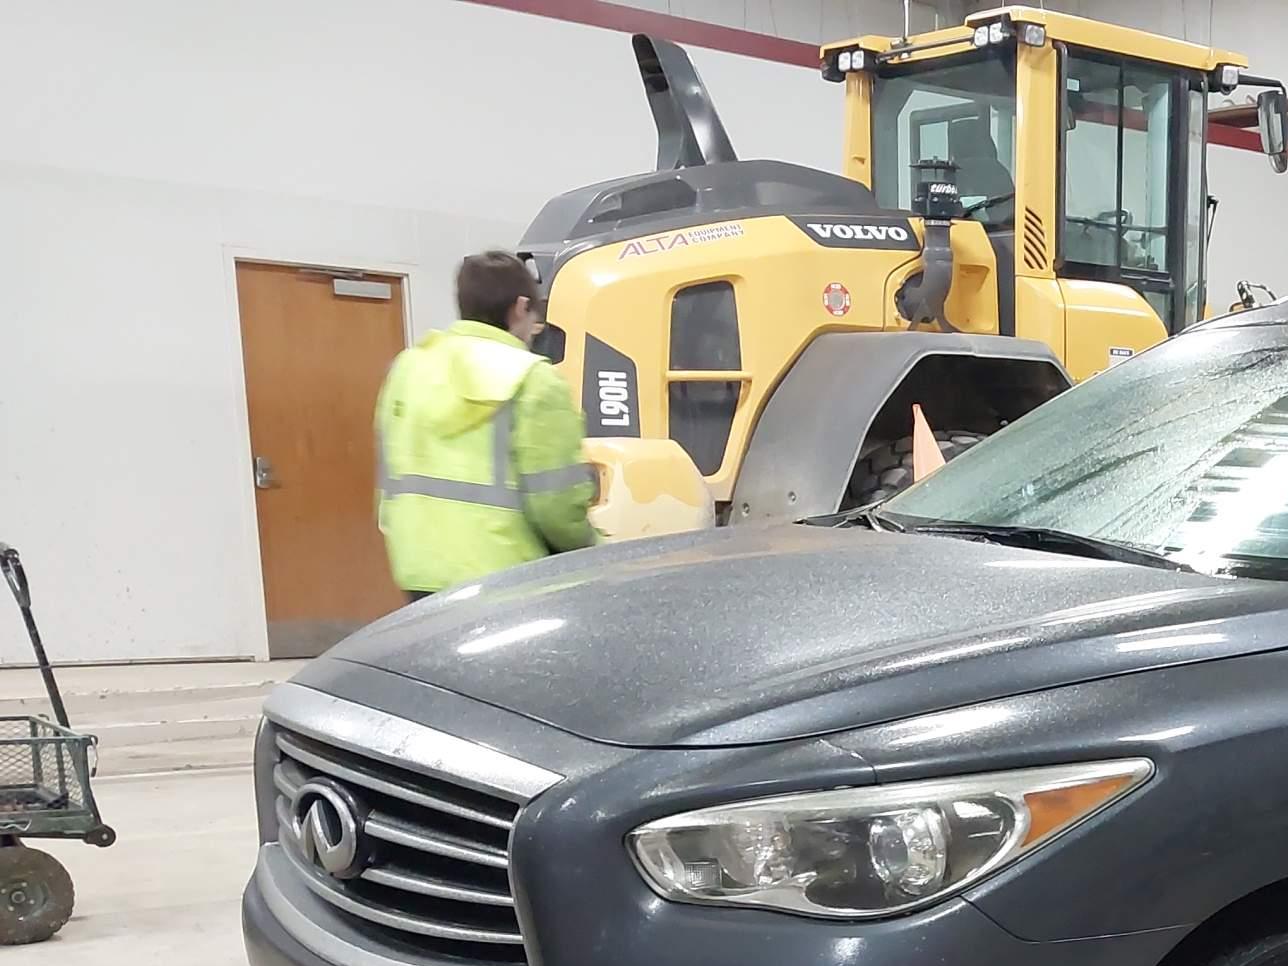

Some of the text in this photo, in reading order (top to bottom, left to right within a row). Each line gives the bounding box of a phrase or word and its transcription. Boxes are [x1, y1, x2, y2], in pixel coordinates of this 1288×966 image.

[688, 224, 742, 238] EQUIPMENT
[691, 230, 744, 243] COMPANY
[806, 223, 908, 241] VOLVO
[619, 233, 689, 260] ALTA
[598, 371, 630, 426] L90H
